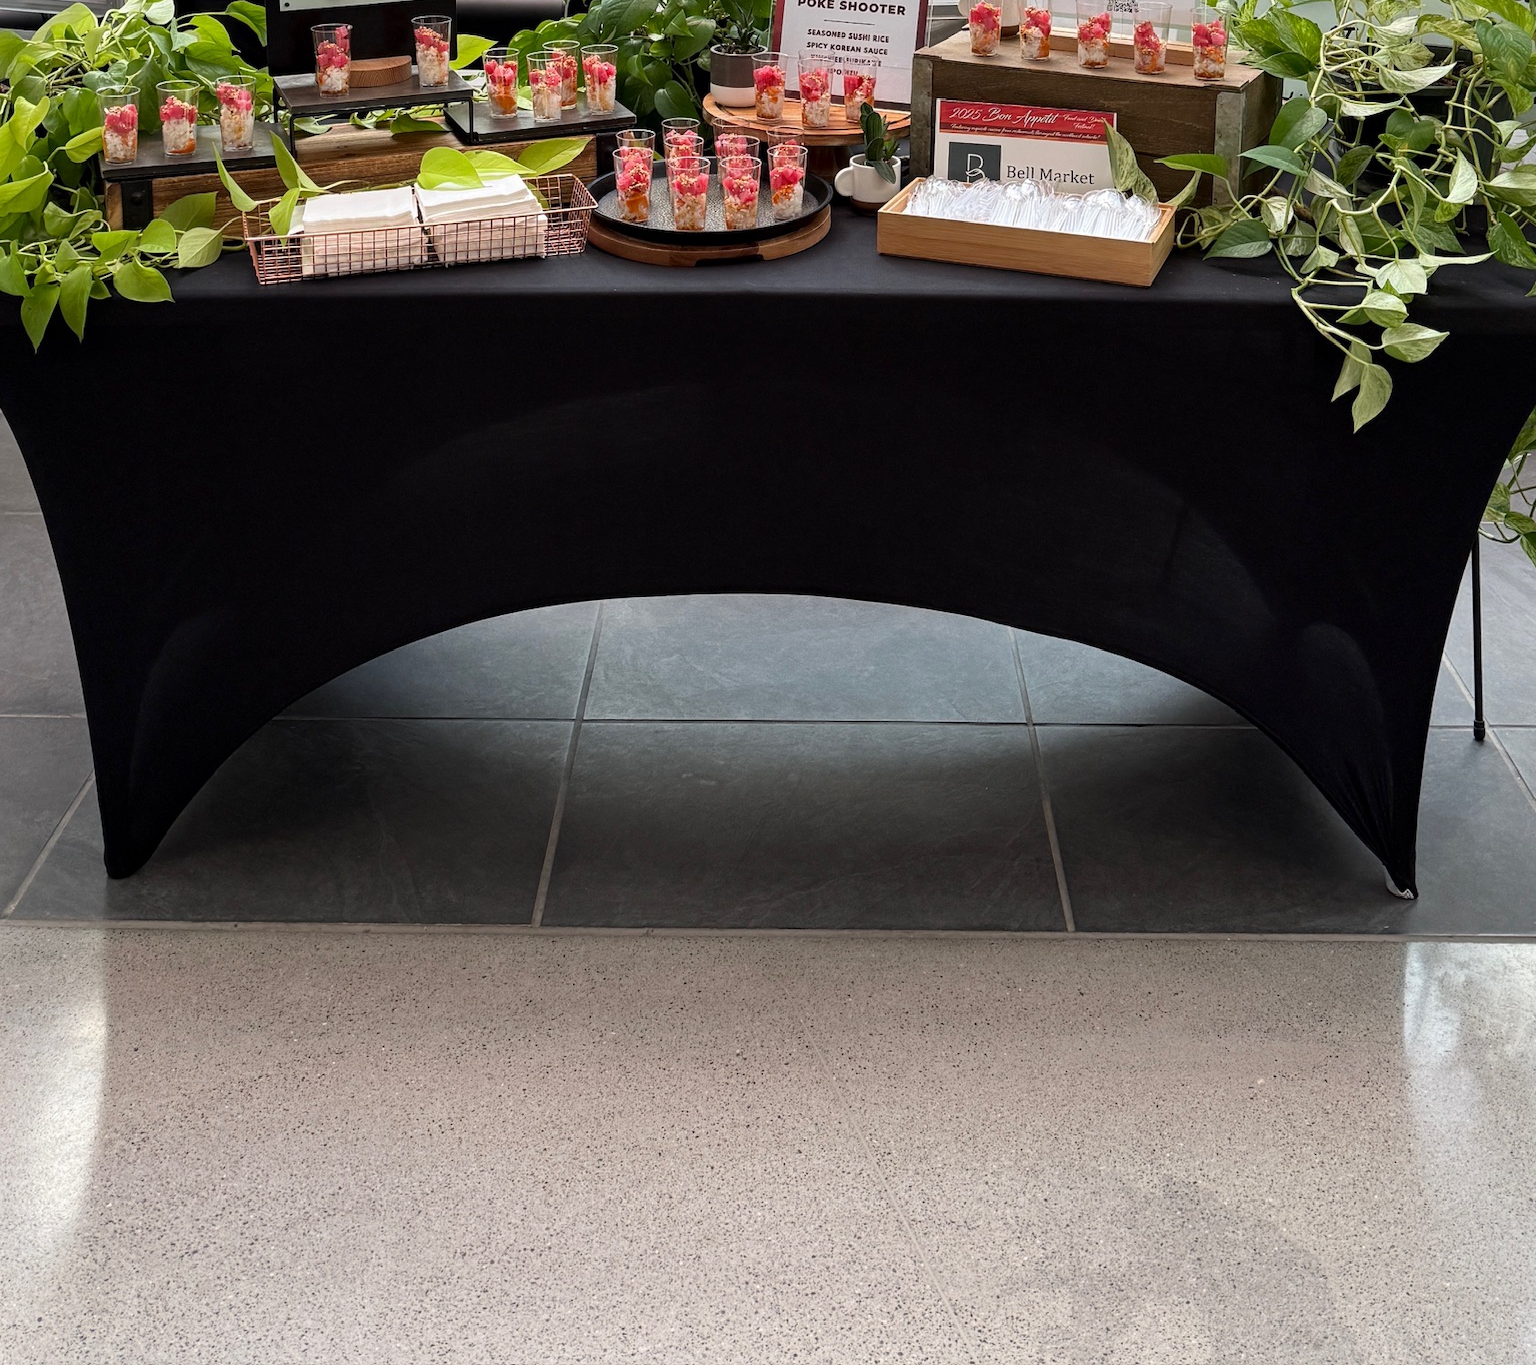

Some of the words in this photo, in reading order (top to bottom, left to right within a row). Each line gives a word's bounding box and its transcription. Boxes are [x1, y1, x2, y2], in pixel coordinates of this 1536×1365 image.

[839, 0, 906, 16] SHOOTER
[807, 28, 846, 38] SEASONED
[848, 32, 871, 42] SUSHI
[872, 35, 890, 43] RICE
[806, 41, 828, 49] SPICY
[830, 43, 862, 53] KOREAN
[863, 47, 888, 55] SAUCE
[949, 107, 983, 120] 2025
[982, 107, 1012, 122] Bon
[1006, 165, 1034, 181] Bell
[1040, 168, 1095, 185] Market
